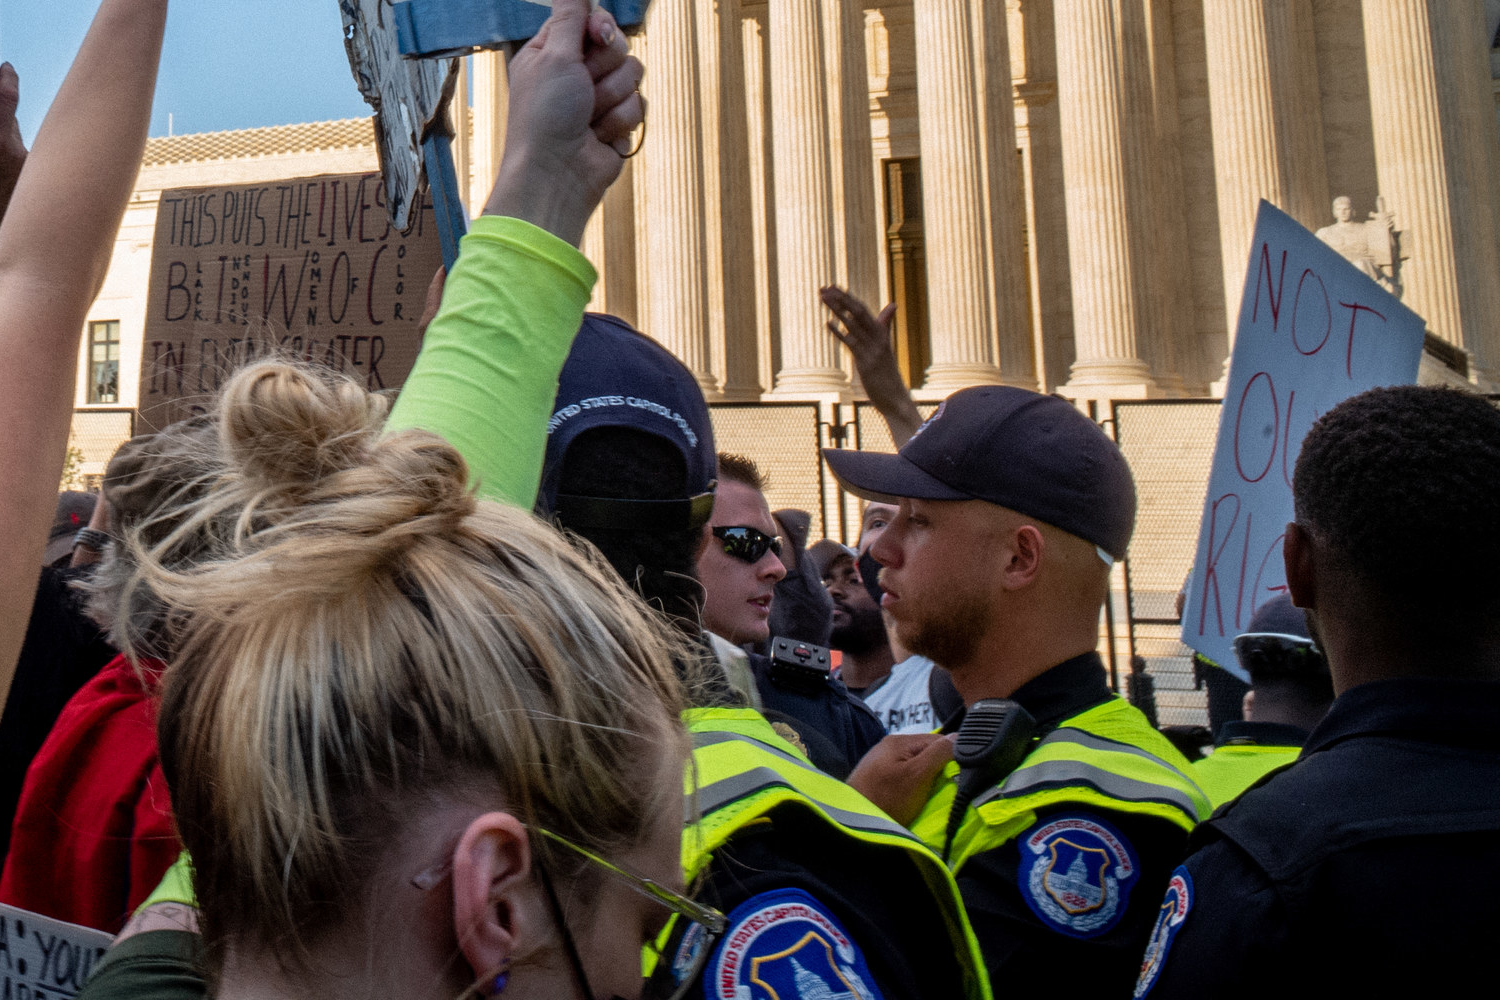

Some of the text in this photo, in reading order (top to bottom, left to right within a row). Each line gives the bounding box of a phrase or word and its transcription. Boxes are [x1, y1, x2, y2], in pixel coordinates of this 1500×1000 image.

[166, 194, 217, 248] THIS
[220, 186, 269, 247] PUTS
[275, 182, 317, 250] THE
[318, 173, 392, 245] LIVES
[1252, 243, 1387, 380] NOT
[149, 340, 186, 394] IN
[580, 395, 625, 410] STATES
[1199, 492, 1291, 637] RIG
[33, 930, 106, 993] YOU
[722, 951, 739, 999] UNITED
[731, 916, 765, 951] STATES
